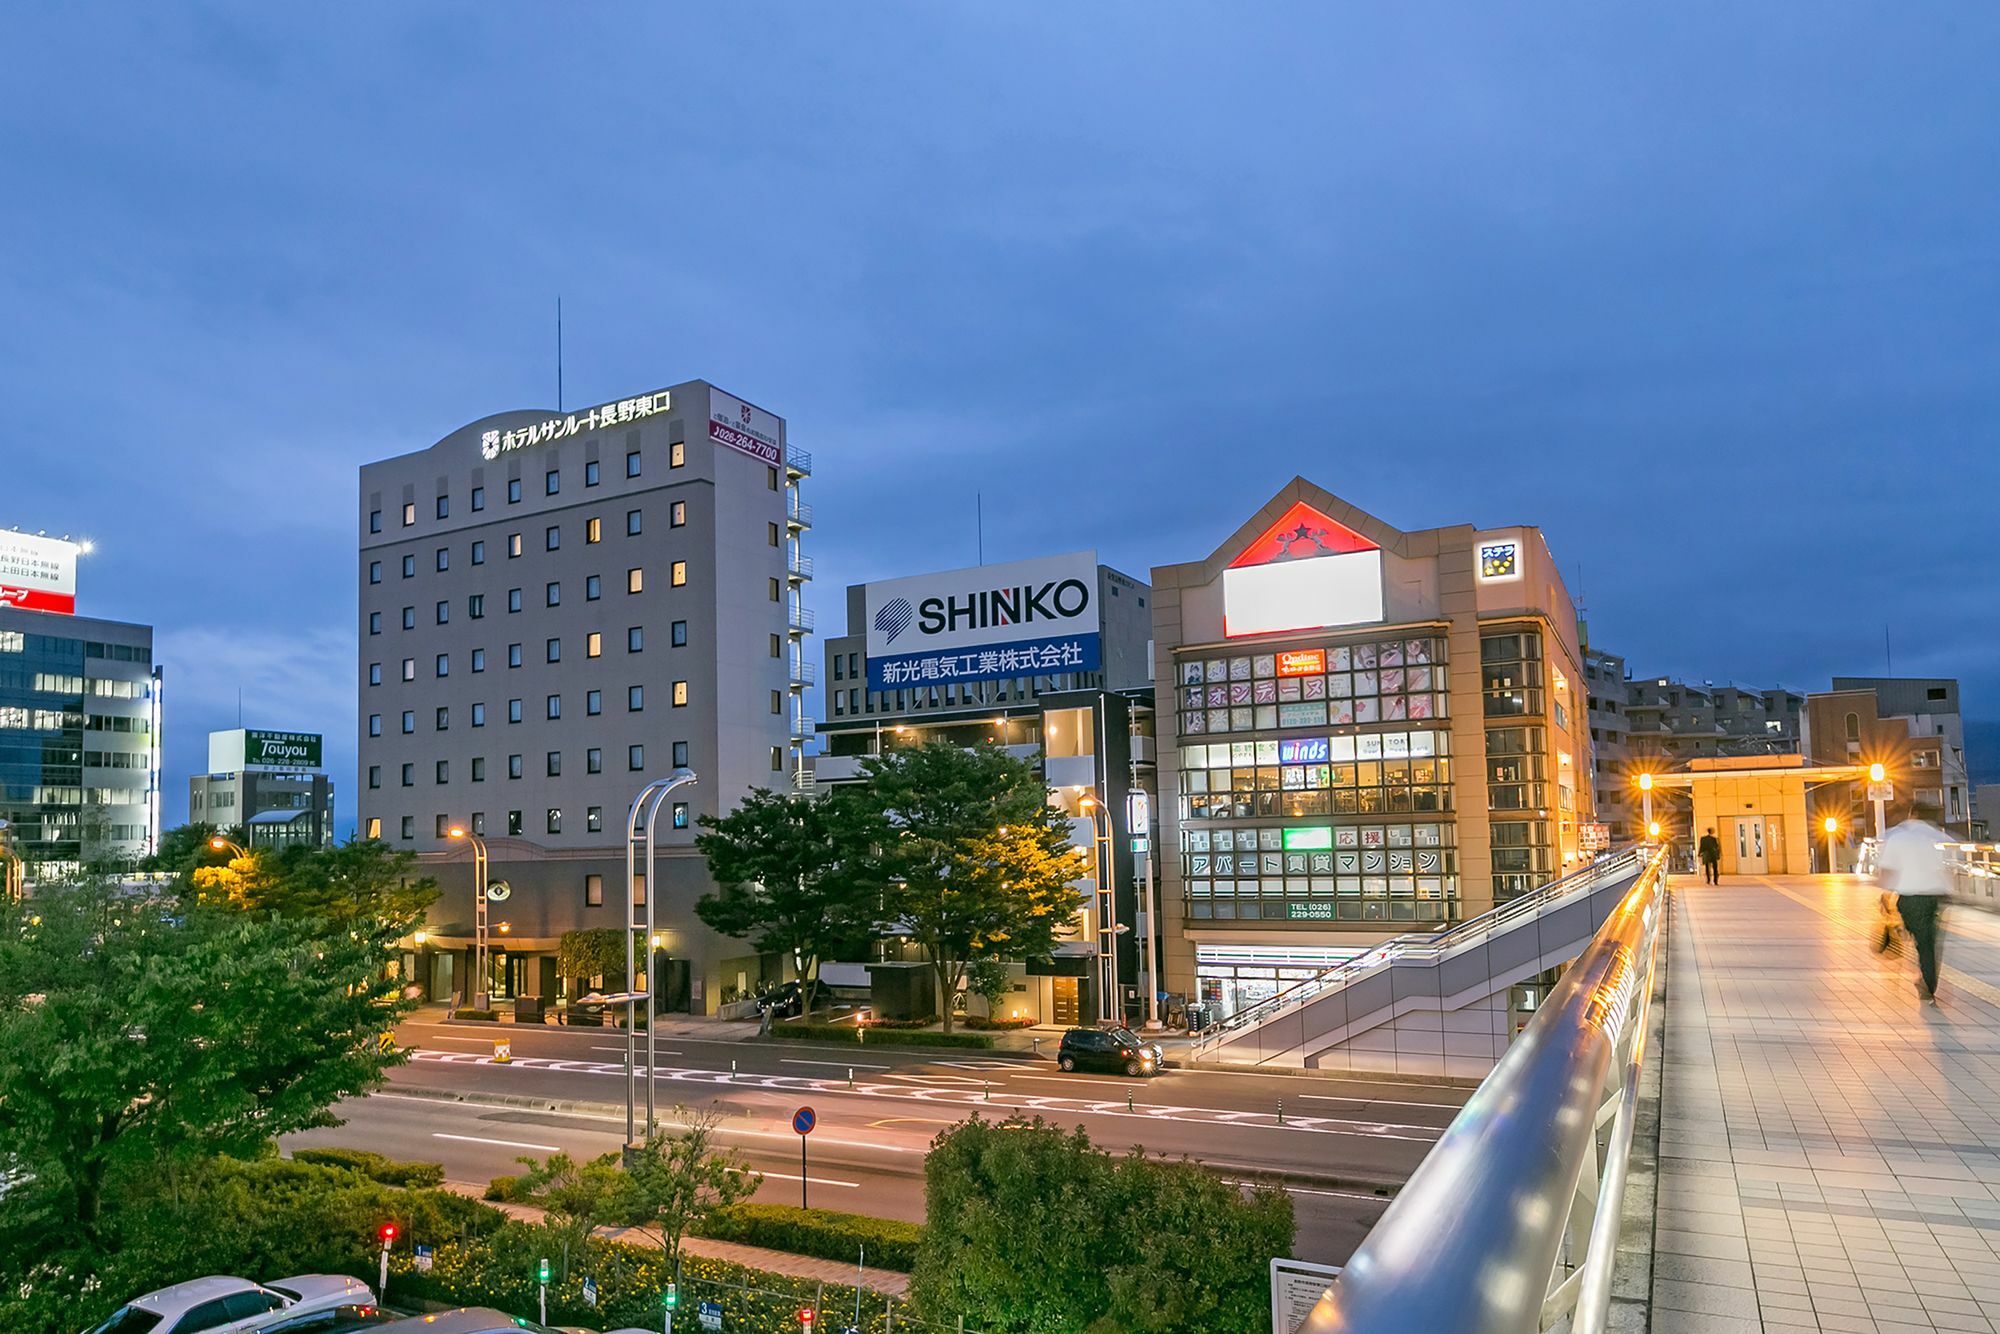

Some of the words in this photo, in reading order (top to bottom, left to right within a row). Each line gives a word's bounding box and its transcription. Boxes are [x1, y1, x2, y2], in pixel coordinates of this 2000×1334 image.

[502, 390, 671, 452] ホテルサンルート長野東口
[719, 428, 777, 461] 026-264-7700
[1482, 545, 1515, 559] ステラ
[0, 565, 60, 581] 上田日本無線
[918, 578, 1089, 634] SHINKO
[882, 641, 1083, 684] 新光電気工業株式会社
[1208, 678, 1324, 706] オンディーヌ
[261, 739, 307, 758] Touyou
[1282, 741, 1328, 761] winds
[1192, 852, 1437, 874] アパート賃貸マンション
[1291, 903, 1308, 911] TEL
[1309, 902, 1332, 912] (026)
[1291, 911, 1332, 919] 229-0550
[701, 1302, 708, 1315] 3
